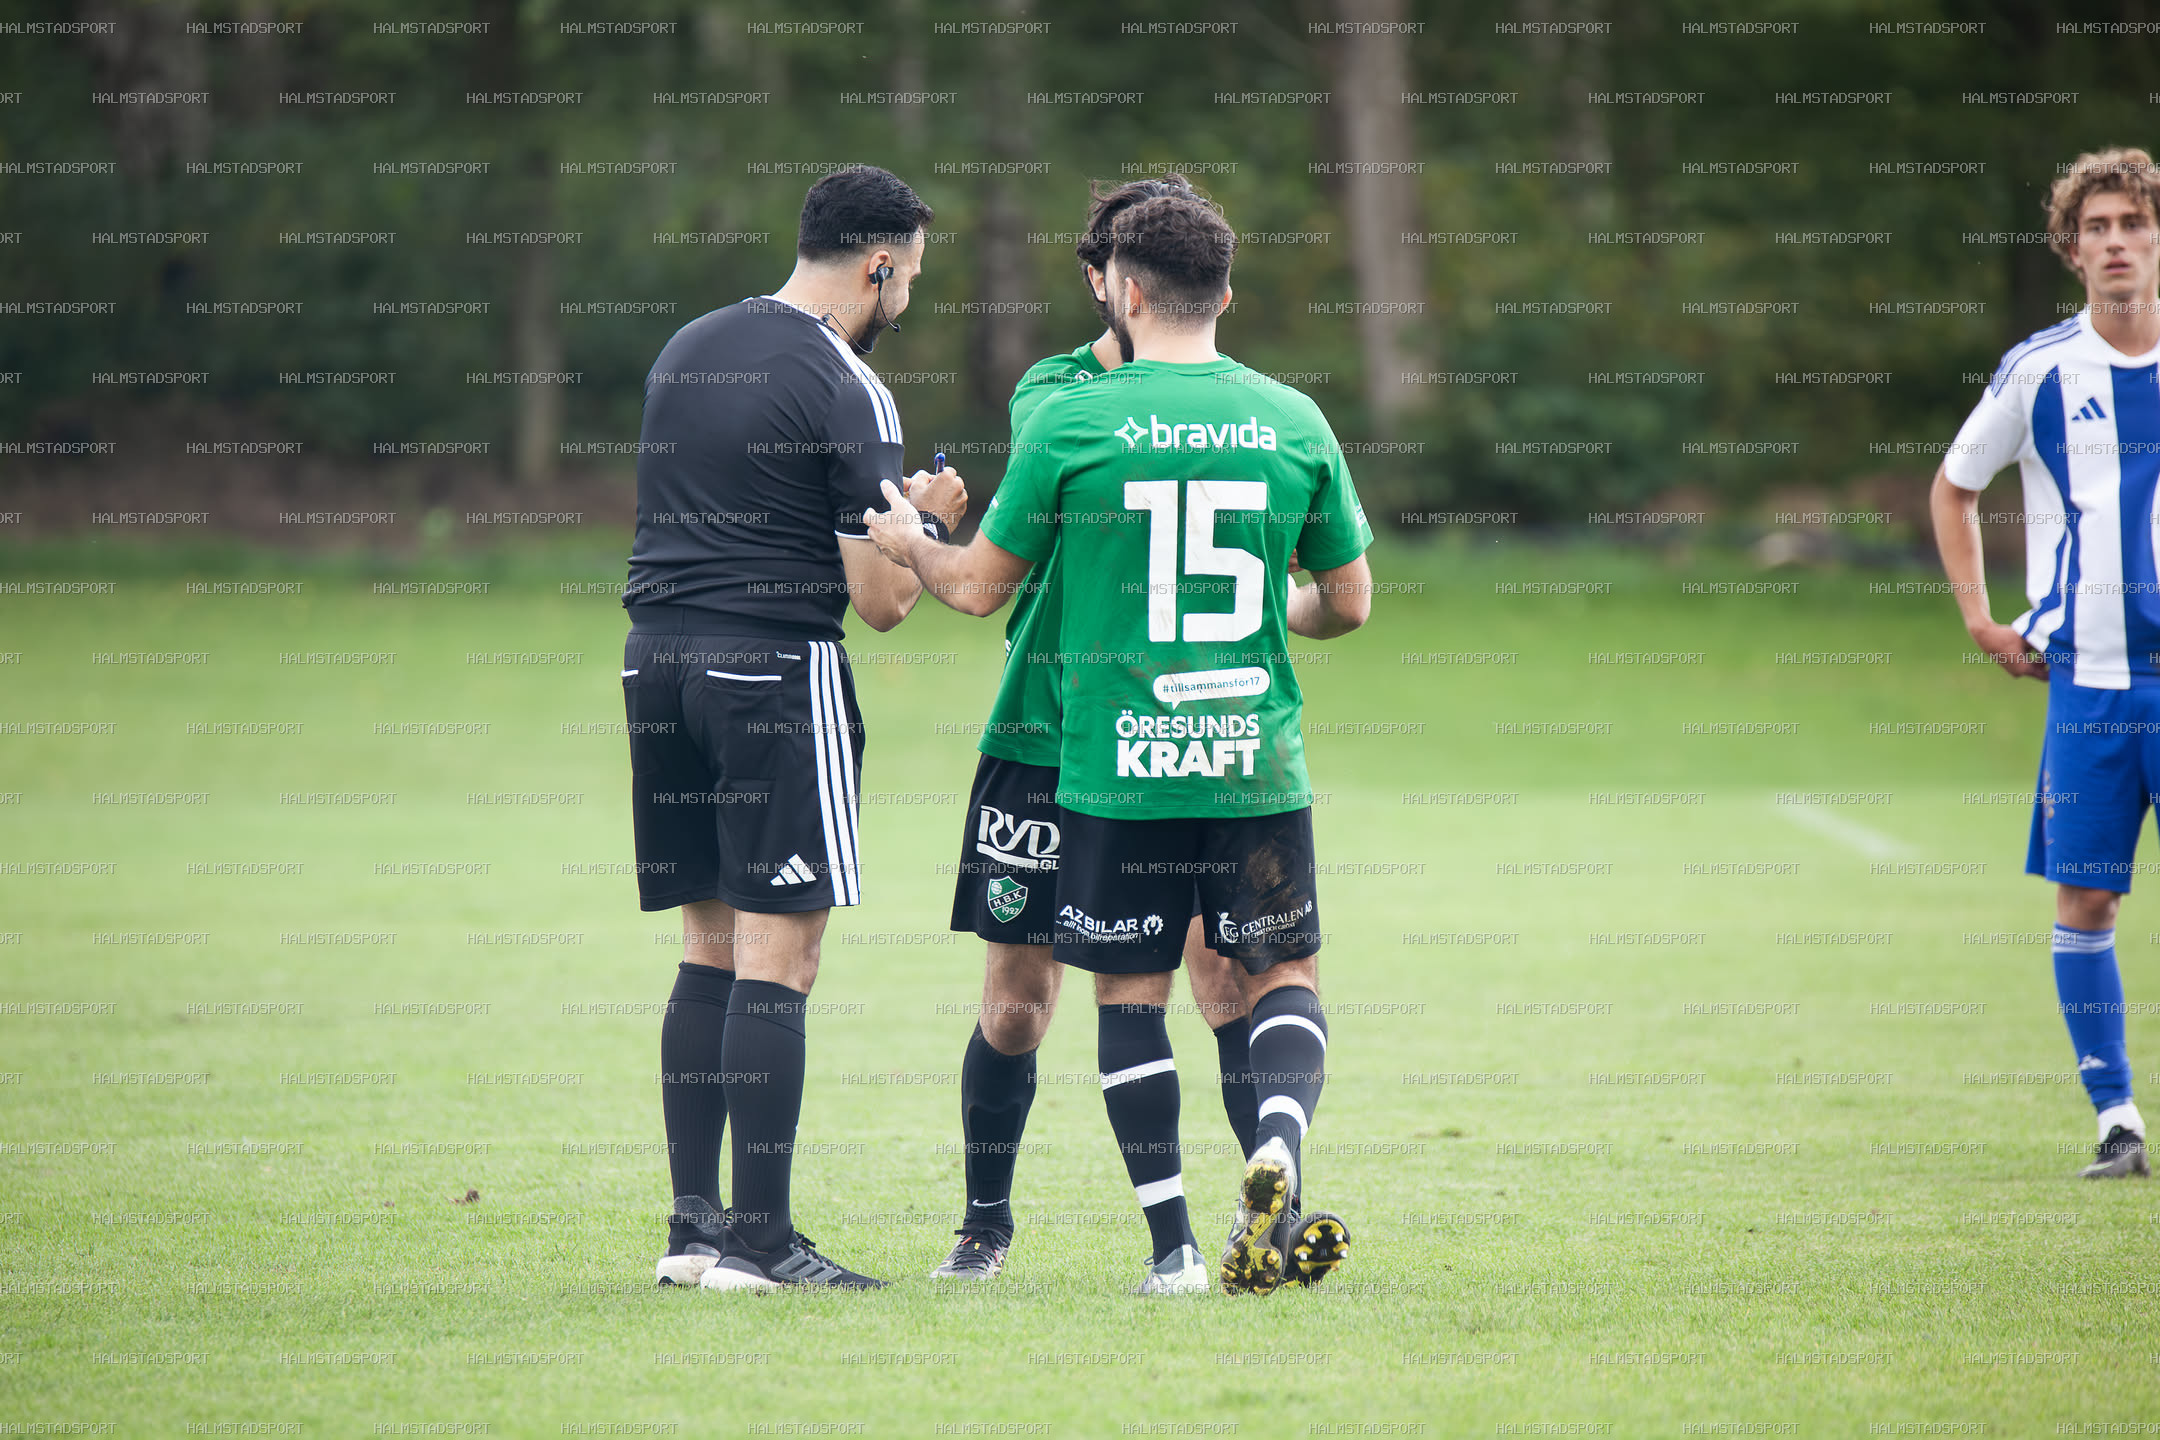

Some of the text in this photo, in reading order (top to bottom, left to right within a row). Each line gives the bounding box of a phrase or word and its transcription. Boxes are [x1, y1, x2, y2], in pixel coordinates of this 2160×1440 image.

[1150, 414, 1277, 451] bravida
[1124, 480, 1268, 642] 15
[1115, 709, 1260, 738] ÖRESUNDS
[1117, 738, 1261, 778] KRAFT
[978, 805, 1060, 859] RYD
[1059, 904, 1139, 933] AZBILAR
[1241, 907, 1304, 936] CENTRALEN
